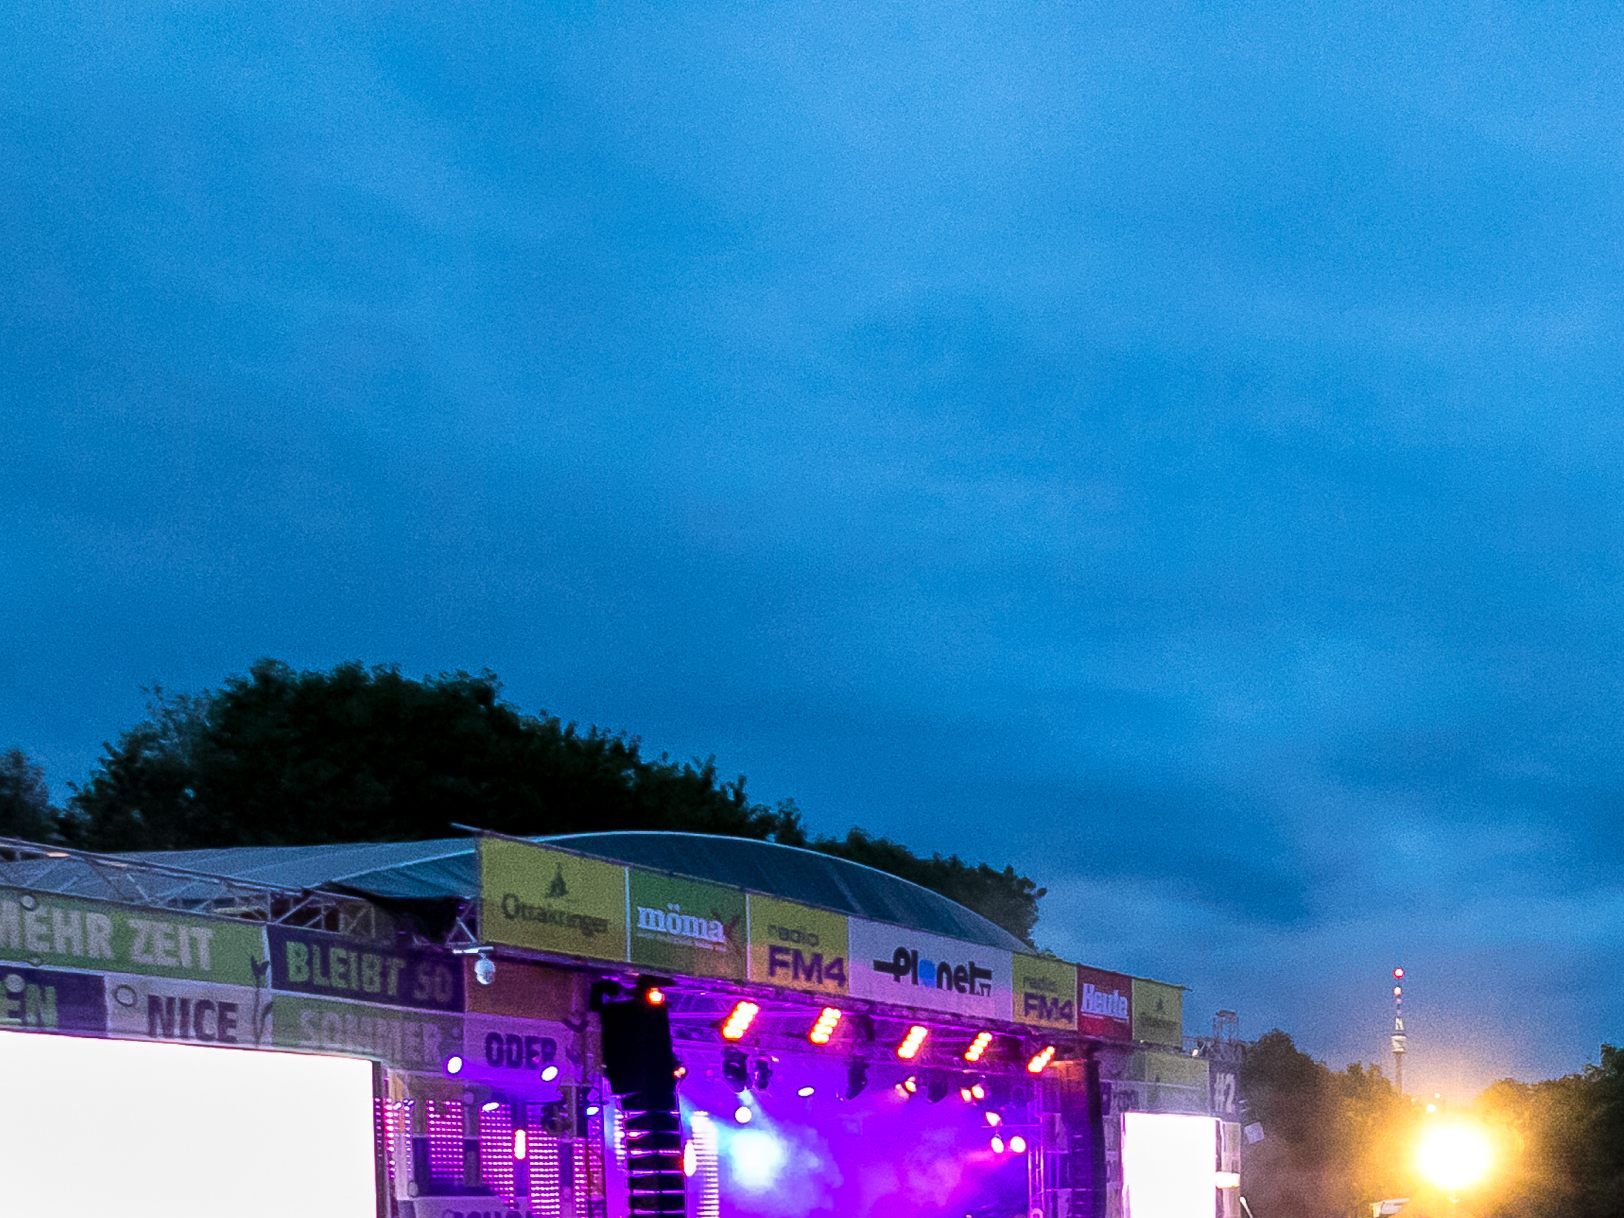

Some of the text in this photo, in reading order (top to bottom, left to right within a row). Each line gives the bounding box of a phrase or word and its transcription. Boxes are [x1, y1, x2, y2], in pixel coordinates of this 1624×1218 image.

[127, 918, 213, 971] ZEIT
[768, 944, 848, 987] FM4
[286, 941, 405, 996] BLEIBT
[147, 994, 239, 1043] NICE
[1023, 992, 1074, 1025] FM4
[485, 1031, 557, 1070] ODER
[1213, 1072, 1235, 1113] #2
